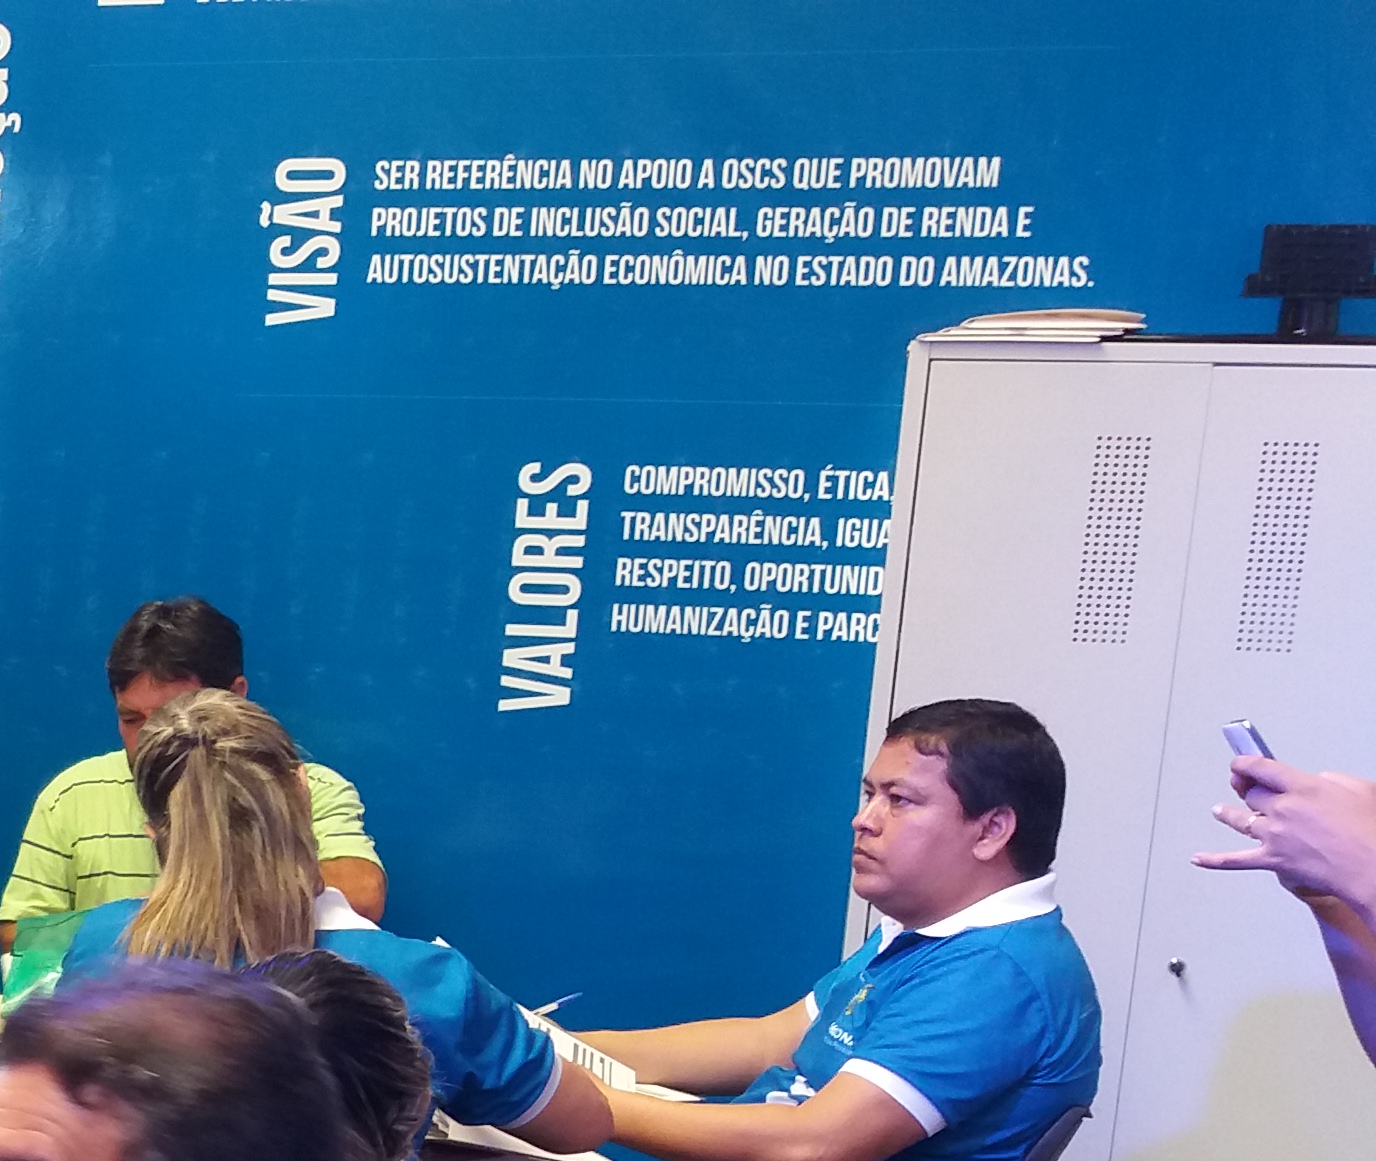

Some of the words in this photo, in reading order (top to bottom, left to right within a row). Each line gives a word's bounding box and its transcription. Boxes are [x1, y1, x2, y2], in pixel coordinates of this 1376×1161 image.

[374, 159, 421, 191] SER
[426, 153, 573, 190] REFERÊNCIA
[579, 158, 614, 190] NO
[618, 158, 693, 190] APOIO
[698, 158, 715, 189] A
[722, 157, 788, 190] OSCS
[793, 157, 845, 190] QUE
[850, 156, 1002, 189] PROMOVAM
[260, 156, 347, 327] VISÃO
[370, 206, 488, 237] PROJETOS
[493, 206, 526, 237] DE
[530, 202, 650, 237] INCLUSÃO
[655, 206, 749, 242] SOCIAL,
[756, 201, 875, 243] GERAÇÃO
[881, 206, 917, 238] DE
[921, 206, 1009, 238] RENDA
[1016, 206, 1035, 238] E
[366, 249, 598, 290] AUTOSUSTENTAÇÃO
[603, 249, 748, 286] ECONÔMICA
[754, 255, 790, 286] NO
[795, 255, 894, 287] ESTADO
[899, 255, 936, 287] DO
[940, 255, 1096, 288] AMAZONAS.
[623, 464, 810, 503] COMPROMISSO,
[621, 509, 829, 550] TRANSPARÊNCIA,
[835, 517, 891, 549] IGUA
[498, 461, 593, 712] VALORES
[616, 557, 737, 594] RESPEITO,
[744, 561, 885, 596] OPORTUNID
[611, 602, 790, 643] HUMANIZAÇÃO
[795, 610, 812, 640] E
[817, 611, 881, 642] PARC
